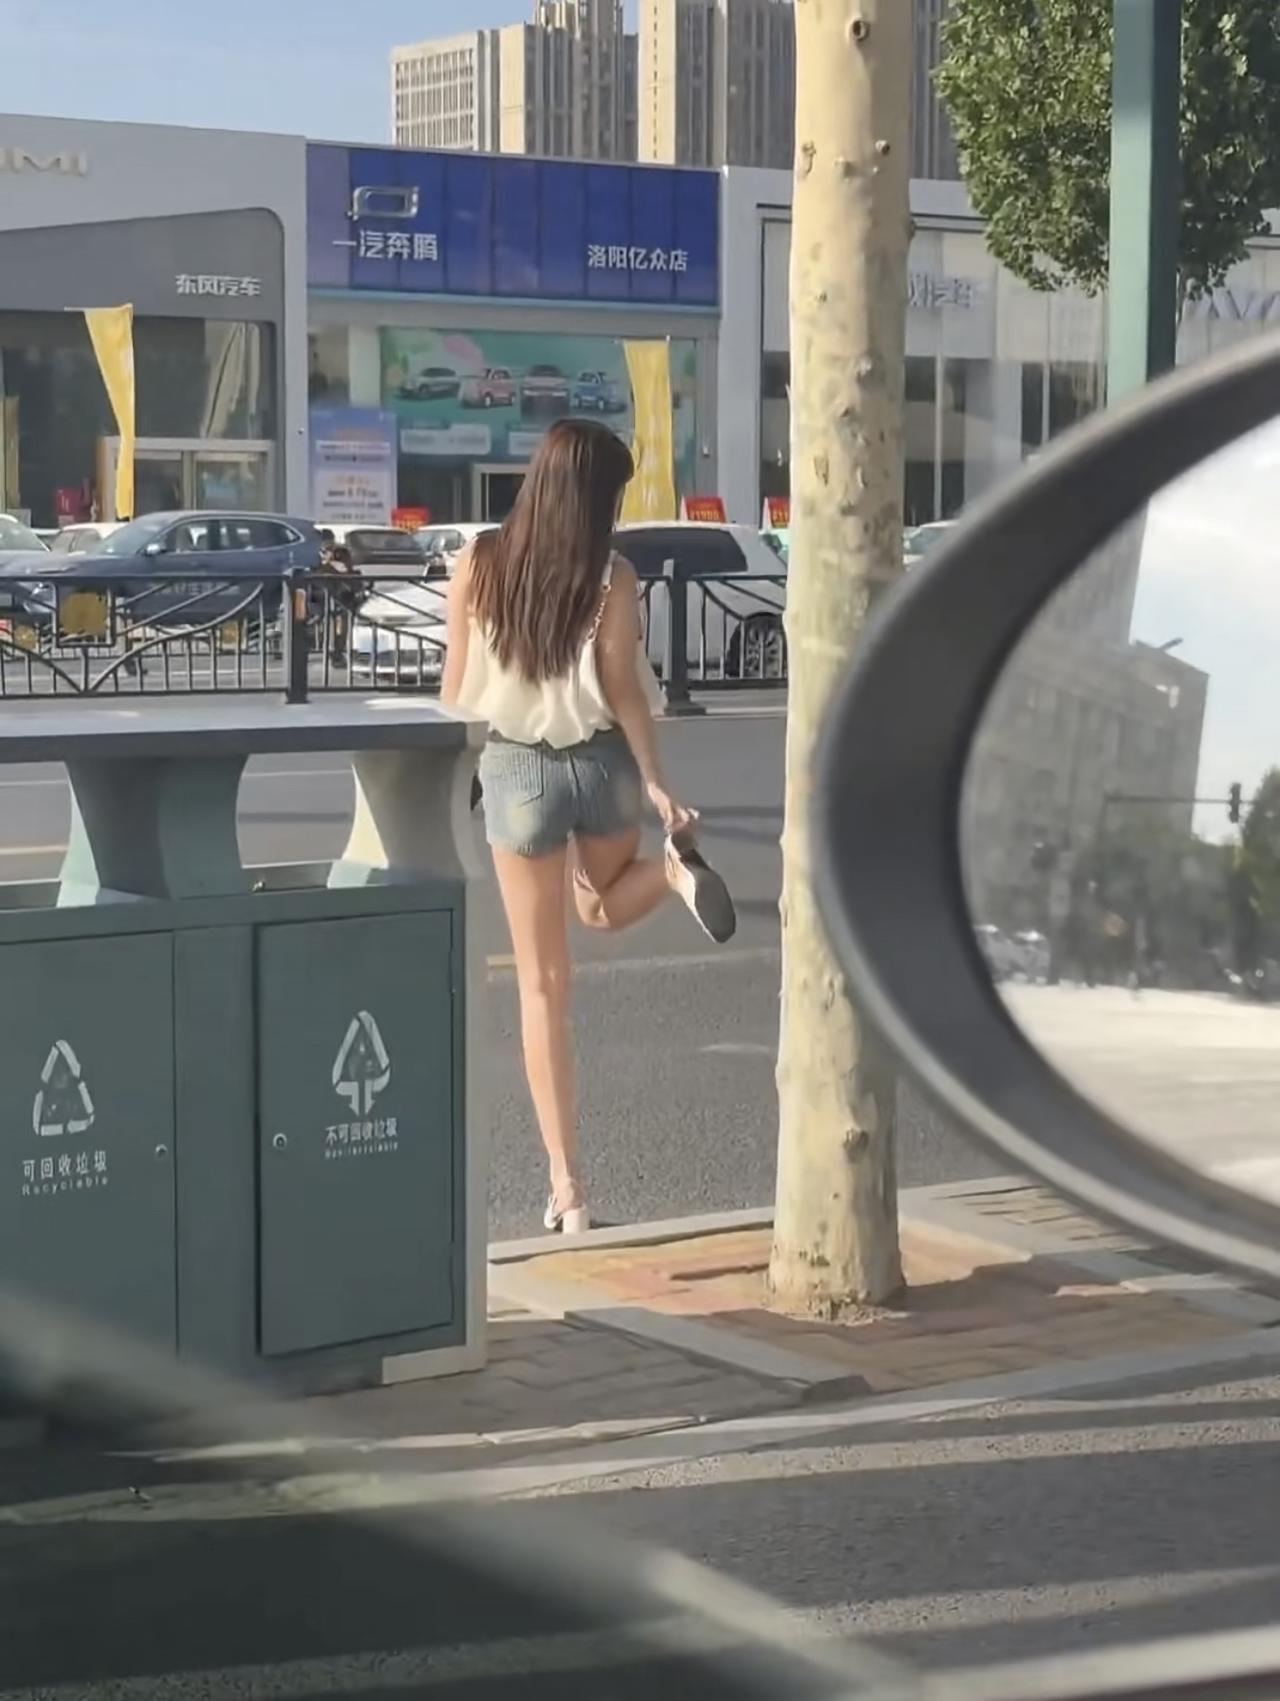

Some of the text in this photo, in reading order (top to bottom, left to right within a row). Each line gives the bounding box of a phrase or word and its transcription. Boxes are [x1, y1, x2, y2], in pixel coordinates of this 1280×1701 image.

[332, 230, 438, 260] 一汽奔腾
[588, 245, 688, 271] 洛阳亿众店
[175, 275, 261, 296] 东风汽车
[23, 1150, 107, 1182] 可回收垃圾
